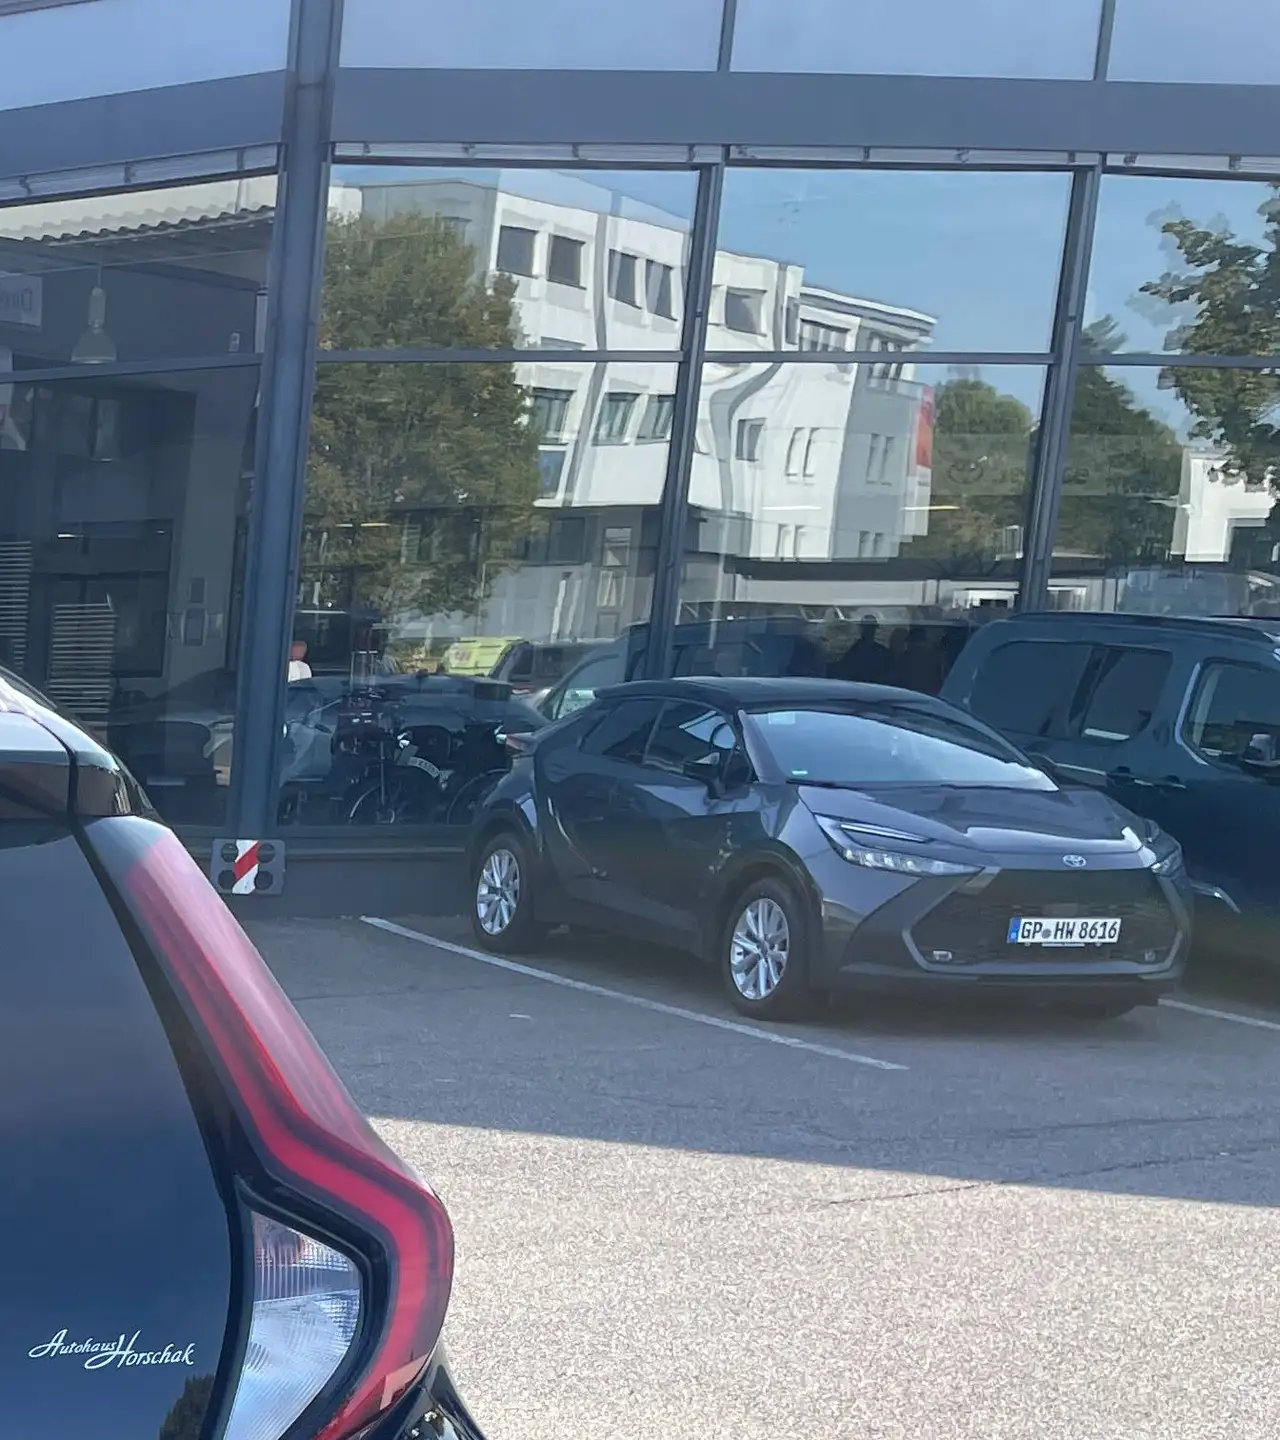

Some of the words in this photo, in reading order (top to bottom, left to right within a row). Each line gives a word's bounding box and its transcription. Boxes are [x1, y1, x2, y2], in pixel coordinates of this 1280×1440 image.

[1020, 921, 1043, 940] GP
[1053, 921, 1076, 940] HW
[1078, 921, 1118, 940] 8616
[28, 1328, 117, 1358] Autohaus
[84, 1329, 196, 1370] Horschak
